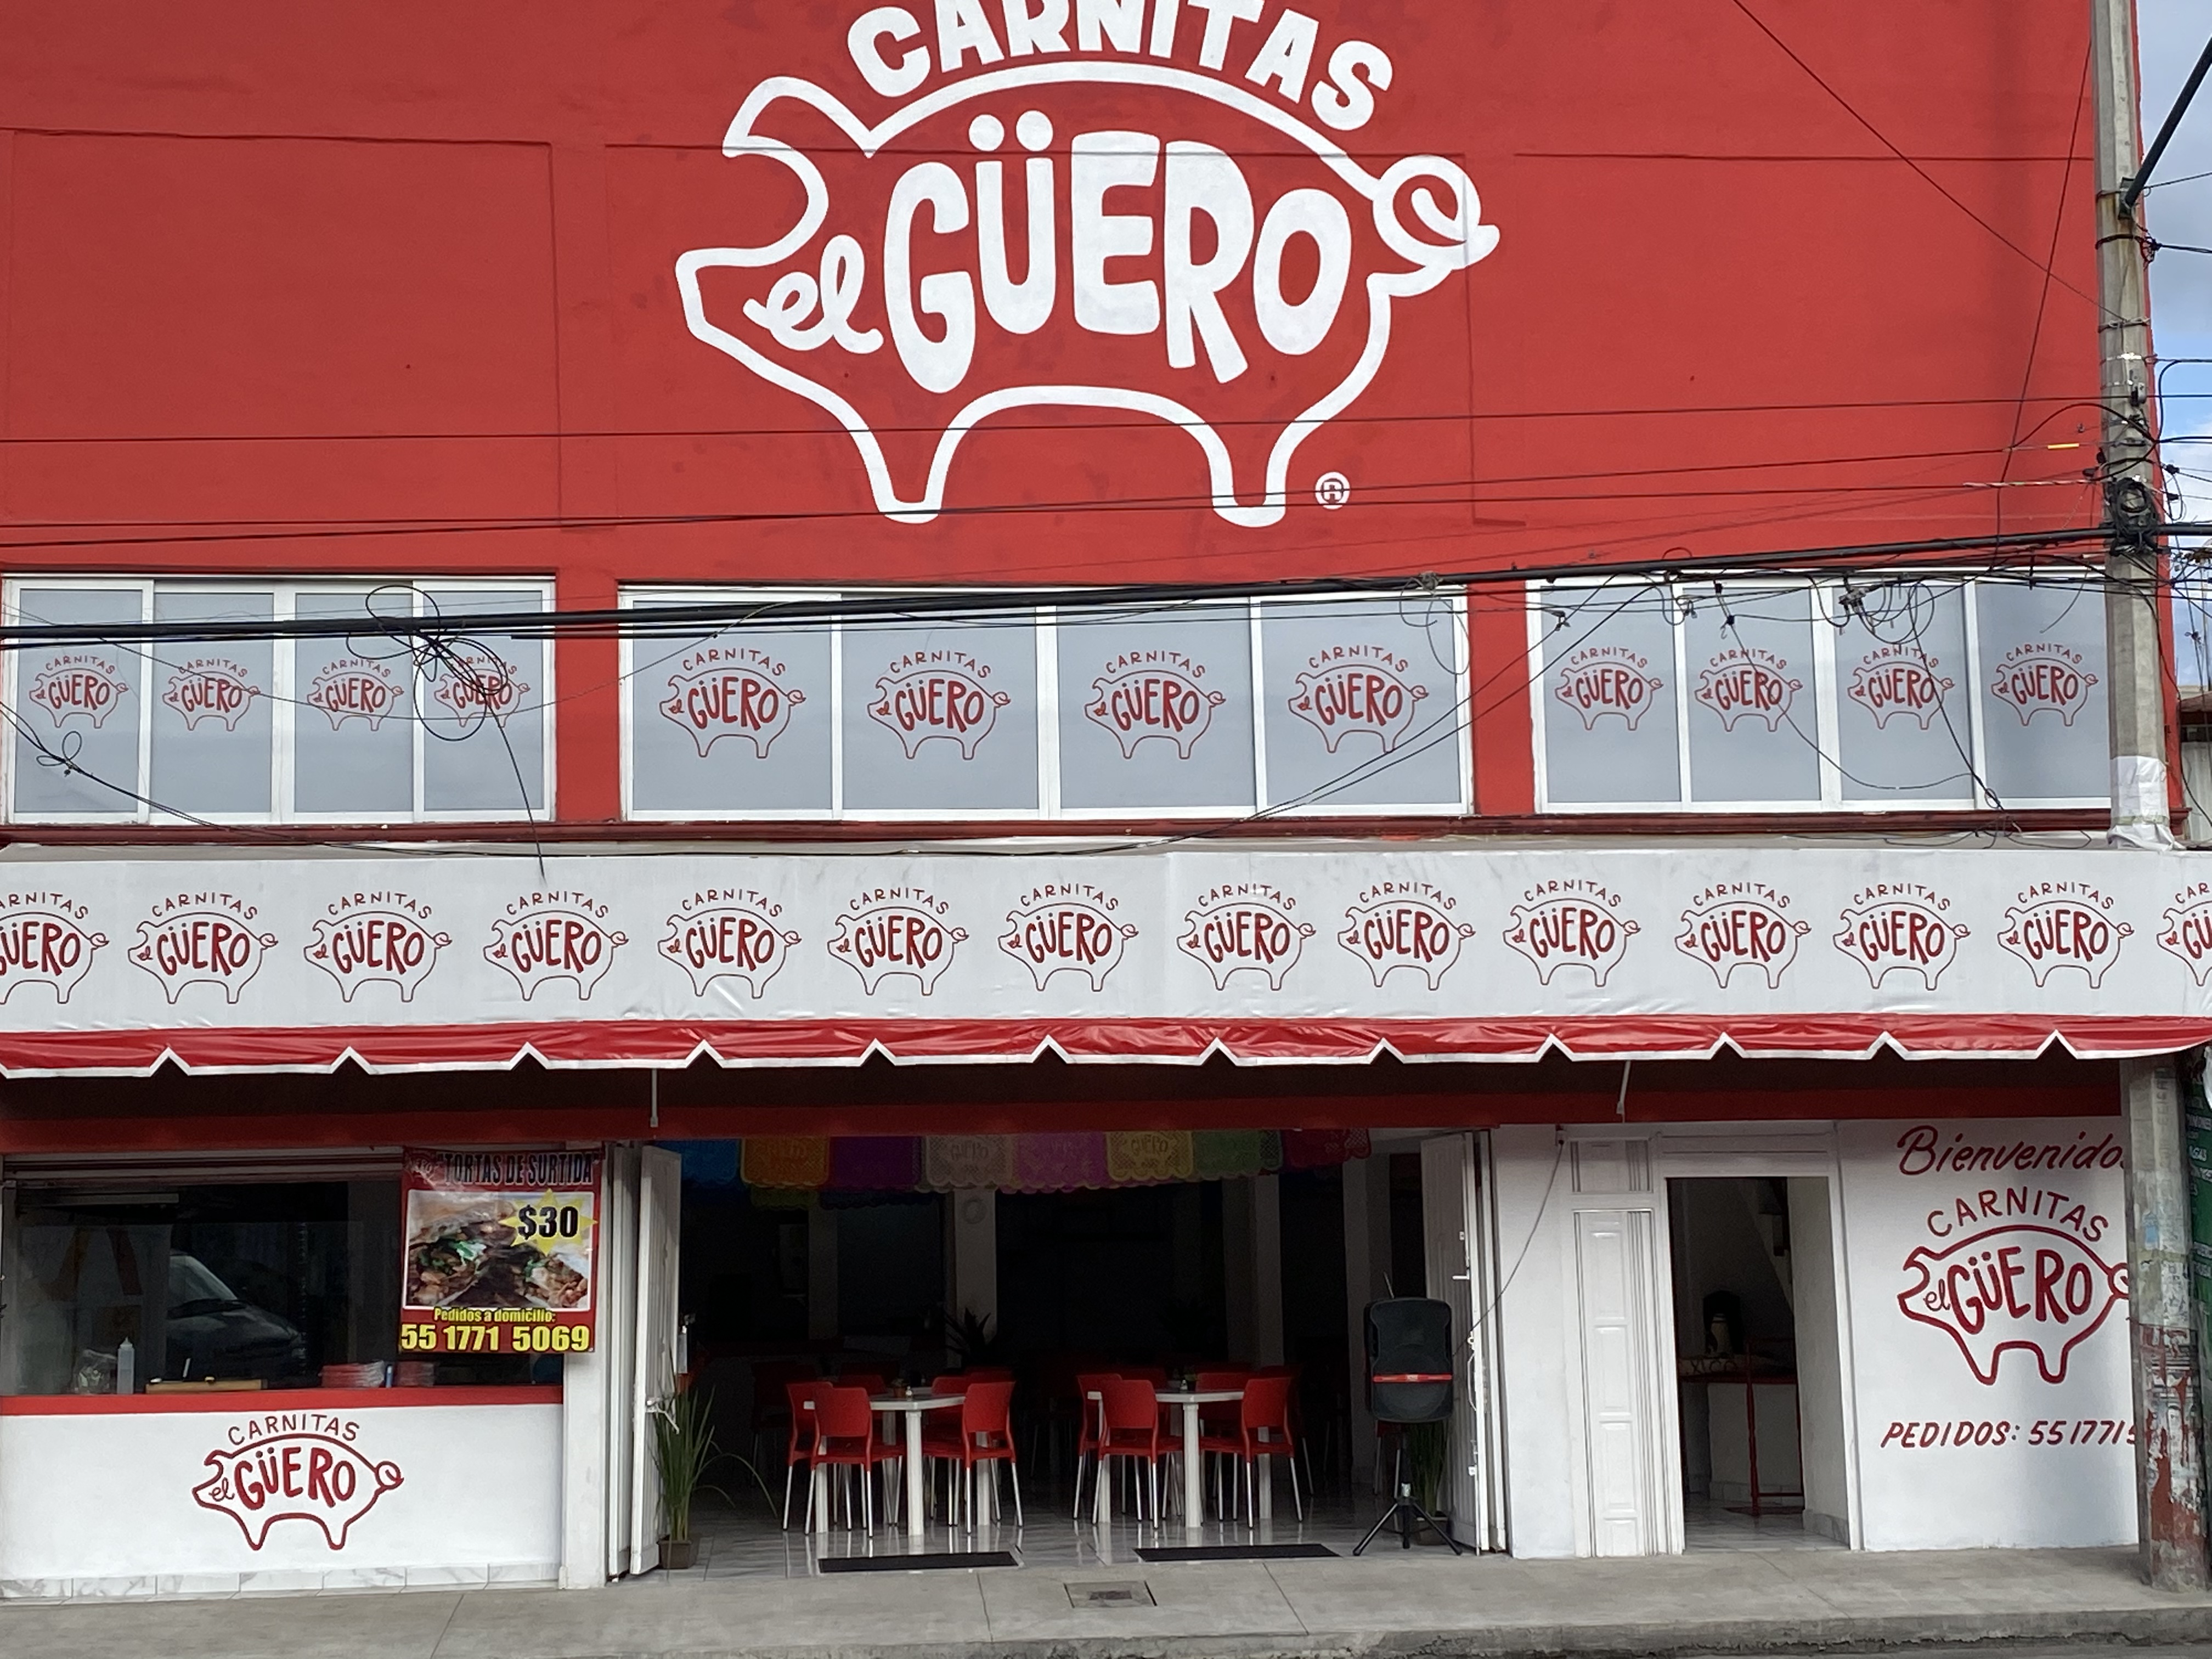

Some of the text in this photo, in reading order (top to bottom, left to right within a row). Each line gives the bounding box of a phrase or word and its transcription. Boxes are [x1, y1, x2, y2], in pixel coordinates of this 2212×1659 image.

[847, 0, 1393, 131] CARNITAS
[743, 110, 1351, 394] el GÜERO
[46, 656, 115, 675] CARNITAS
[322, 659, 391, 678] CARNITAS
[683, 647, 786, 676] CARNITAS
[890, 651, 991, 679] CARNITAS
[1105, 651, 1205, 678] CARNITAS
[1308, 645, 1409, 673] CARNITAS
[1571, 647, 1647, 668] CARNITAS
[1709, 648, 1787, 670] CARNITAS
[2006, 644, 2083, 664] CARNITAS
[48, 674, 110, 710] GÜERO
[181, 678, 242, 713] GÜERO
[325, 678, 386, 713] GÜERO
[688, 676, 778, 730] GÜERO
[1315, 673, 1403, 726] GÜERO
[1576, 669, 1643, 709] GÜERO
[1716, 670, 1782, 711] GÜERO
[1869, 668, 1936, 709] GÜERO
[2012, 665, 2078, 706] GÜERO
[895, 679, 984, 732] GÜERO
[1111, 678, 1199, 732] GÜERO
[0, 892, 88, 919] RNITAS
[152, 892, 258, 920] CARNITAS
[328, 891, 432, 919] CARNITAS
[507, 891, 608, 918] CARNITAS
[682, 889, 782, 917] CARNITAS
[850, 887, 949, 915] CARNITAS
[1020, 883, 1119, 911] CARNITAS
[1198, 883, 1296, 910] CARNITAS
[1359, 881, 1457, 911] CARNITAS
[1524, 879, 1622, 907] CARNITAS
[1693, 882, 1791, 909] CARNITAS
[1854, 882, 1951, 911] CARNITAS
[2017, 881, 2114, 910] CARNITAS
[0, 921, 81, 976] ÜERO
[157, 921, 250, 976] GÜERO
[332, 920, 425, 975] GÜERO
[511, 919, 601, 974] GÜERO
[686, 916, 775, 972] GÜERO
[855, 915, 943, 969] GÜERO
[1025, 911, 1112, 964] GÜERO
[1204, 911, 1290, 964] GÜERO
[1364, 909, 1450, 962] GÜERO
[1529, 907, 1615, 961] GÜERO
[1700, 910, 1786, 963] GÜERO
[1859, 910, 1945, 965] GÜERO
[2023, 909, 2109, 962] GÜERO
[1897, 1125, 2124, 1175] Bienvenido
[517, 1204, 579, 1240] $30
[1927, 1186, 2108, 1242] CARNITAS
[1923, 1280, 1951, 1312] el
[1947, 1246, 2092, 1335] GÜERO
[434, 1307, 482, 1322] Pedidos
[483, 1312, 492, 1322] a
[401, 1324, 590, 1352] 55 1771 5069
[228, 1414, 360, 1445] CARNITAS
[1881, 1421, 2020, 1448] PEDIDOS:
[209, 1447, 356, 1510] el GÜERO
